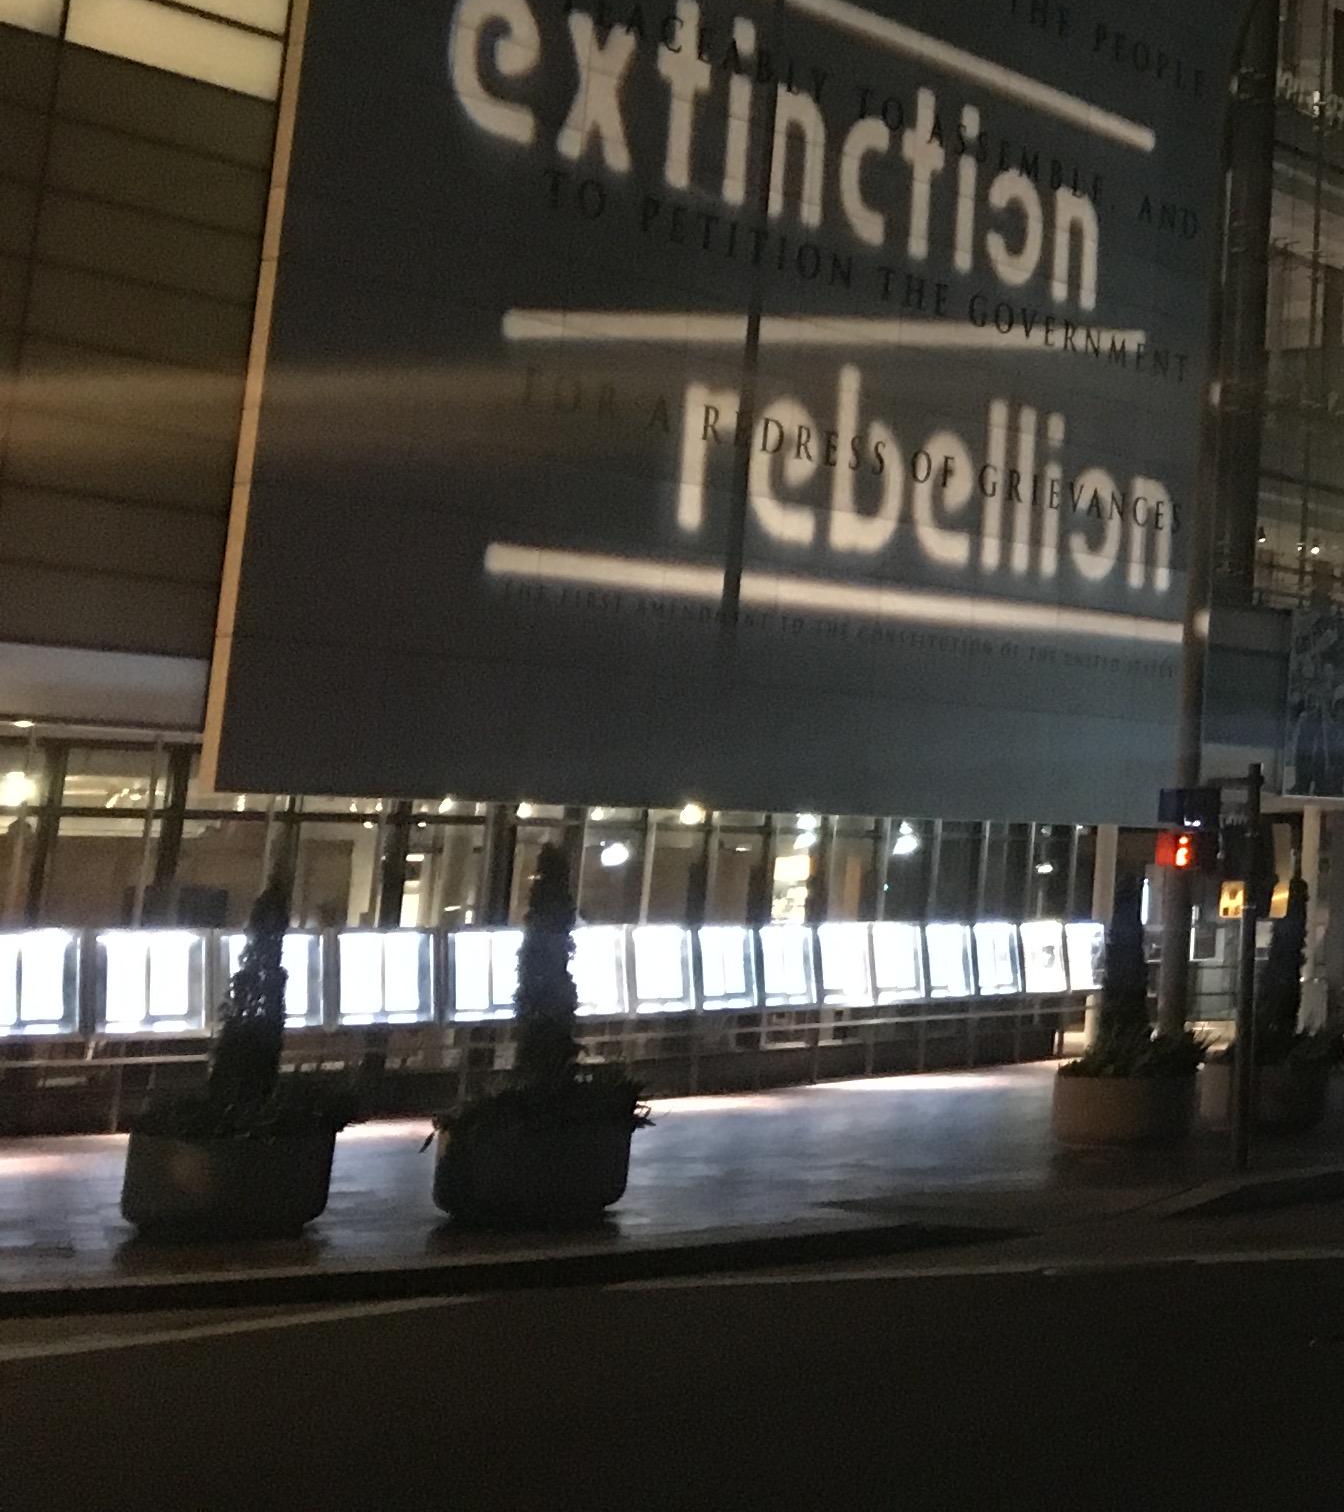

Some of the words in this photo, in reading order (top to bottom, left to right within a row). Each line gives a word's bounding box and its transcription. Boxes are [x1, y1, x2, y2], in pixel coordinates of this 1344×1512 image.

[1094, 20, 1205, 100] PEOPLE
[856, 86, 906, 131] TO
[1138, 194, 1199, 242] AND
[544, 168, 608, 219] TO
[639, 196, 854, 286] PETITION
[876, 264, 950, 318] THE
[968, 293, 1190, 382] GOVERNMENT
[648, 394, 671, 434] A
[700, 401, 887, 477] REDRESS
[910, 448, 957, 490] OF
[978, 463, 1184, 534] GRIEVANCES
[676, 361, 1171, 593] rebellion
